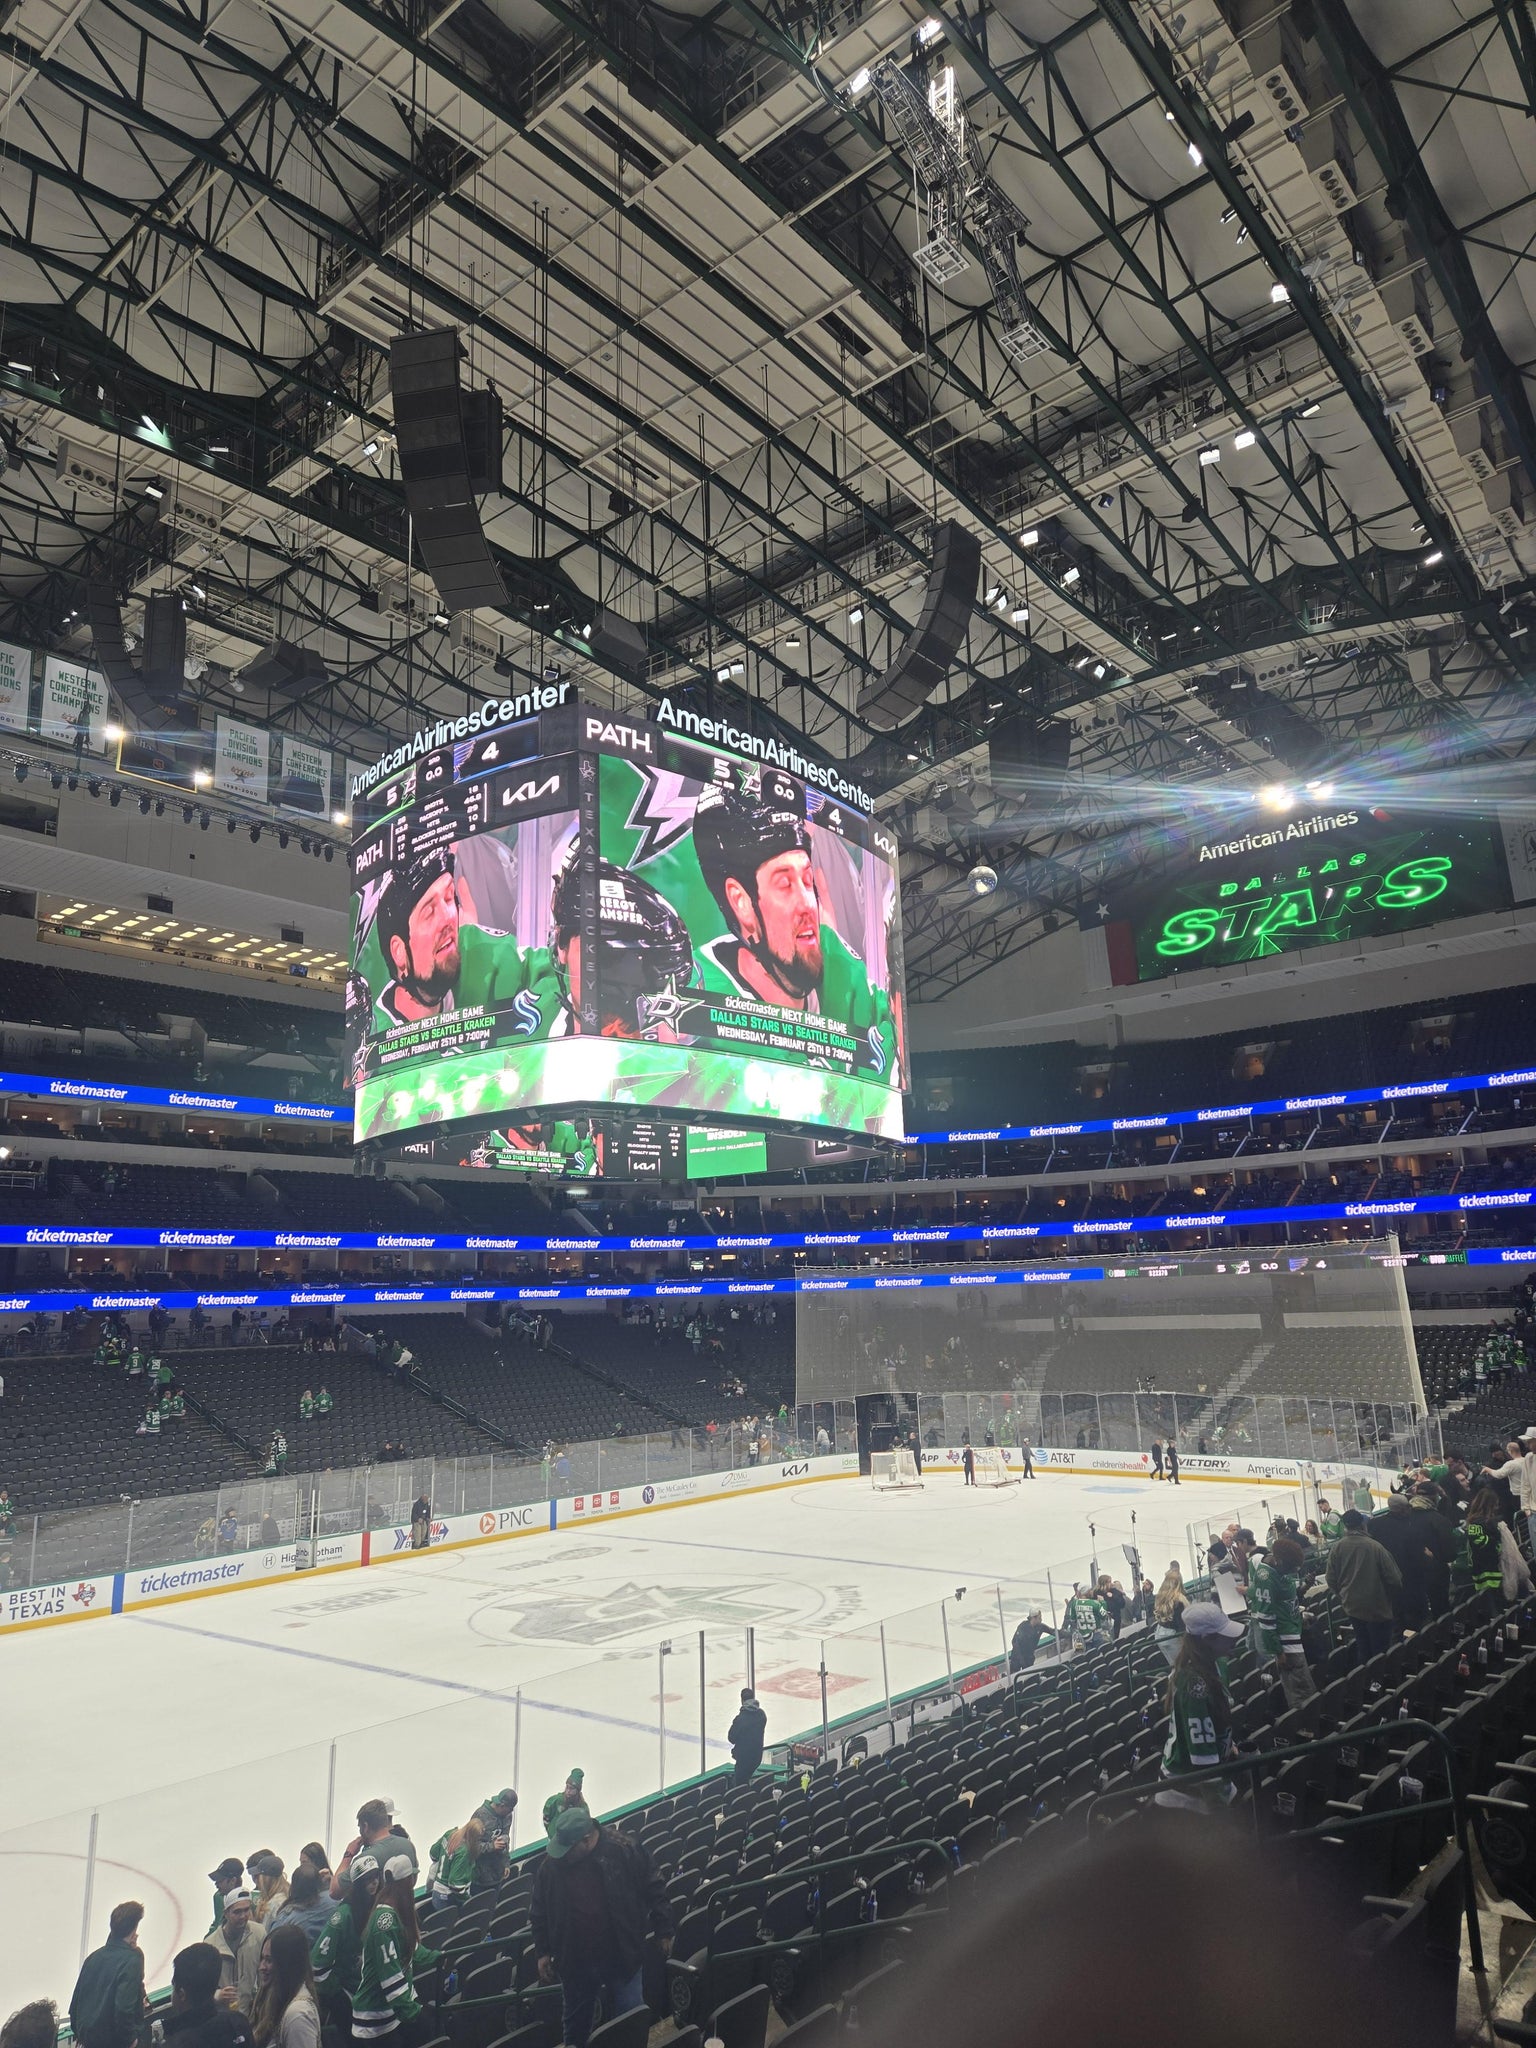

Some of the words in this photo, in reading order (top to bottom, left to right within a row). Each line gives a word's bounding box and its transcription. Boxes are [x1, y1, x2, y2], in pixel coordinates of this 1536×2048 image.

[49, 680, 104, 705] CONFERENCE
[58, 670, 97, 692] WESTERN
[228, 739, 258, 756] DIVISION
[229, 729, 257, 745] PACIFIC
[222, 748, 263, 768] CHAMPIONS
[286, 758, 328, 779] CONFERENCE
[292, 749, 322, 766] WESTERN
[386, 785, 397, 807] 5
[425, 766, 443, 781] 0.0
[481, 741, 499, 760] 4
[223, 782, 258, 797] 1999-2000
[714, 757, 731, 779] 5
[774, 783, 795, 801] 0.0
[829, 808, 842, 826] 4
[424, 798, 444, 811] SHOTS
[426, 818, 441, 829] HITS
[772, 812, 799, 824] CCM
[397, 843, 405, 852] 17
[411, 830, 436, 844] BLOCKED
[436, 821, 457, 834] SHOTS
[468, 813, 479, 822] 10
[413, 838, 438, 853] PENALTY
[438, 832, 455, 842] MINS
[584, 792, 596, 872] TEXAS
[1199, 828, 1285, 862] American
[1286, 808, 1359, 838] Airlines
[1219, 852, 1367, 897] DALLAS
[1155, 856, 1452, 957] STARS
[584, 890, 596, 990] HOCKEY
[386, 1022, 420, 1039] ticketmaster
[420, 1016, 438, 1028] NEXT
[440, 1011, 460, 1024] HOME
[462, 1005, 484, 1018] GAME
[725, 995, 779, 1017] ticketmaster
[782, 1007, 803, 1021] NEXT
[804, 1011, 826, 1028] HOME
[827, 1018, 848, 1034] GAME
[379, 1042, 398, 1054] DALLAS
[399, 1034, 419, 1048] STARS
[421, 1031, 430, 1040] VS
[431, 1023, 462, 1039] SEATTLE
[464, 1016, 496, 1031] KRAKEN
[710, 1009, 750, 1029] DALLAS
[750, 1016, 780, 1033] STARS
[782, 1023, 794, 1035] VS
[796, 1027, 828, 1043] SEATTLE
[830, 1033, 857, 1050] KRAKEN
[717, 1025, 768, 1045] WEDNESDAY,
[769, 1034, 806, 1051] FEBRUARY
[807, 1042, 824, 1055] 25TH
[411, 1042, 439, 1056] FEBRUARY
[441, 1036, 456, 1048] 25TH
[51, 1081, 127, 1098] ticketmaster
[168, 1093, 238, 1110] ticketmaster
[273, 1104, 334, 1118] ticketmaster
[949, 1132, 1000, 1141] ticketmaster
[1030, 1125, 1082, 1136] ticketmaster
[1113, 1118, 1168, 1129] ticketmaster
[1198, 1107, 1253, 1120] ticketmaster
[1286, 1096, 1346, 1110] ticketmaster
[1382, 1084, 1448, 1098] ticketmaster
[26, 1229, 113, 1243] ticketmaster
[160, 1232, 235, 1244] ticketmaster
[276, 1234, 341, 1246] ticketmaster
[377, 1236, 435, 1246] ticketmaster
[467, 1237, 518, 1248] ticketmaster
[546, 1239, 600, 1248] ticketmaster
[630, 1238, 685, 1248] ticketmaster
[717, 1237, 772, 1246] ticketmaster
[805, 1234, 860, 1244] ticketmaster
[892, 1231, 949, 1241] ticketmaster
[983, 1227, 1039, 1237] ticketmaster
[1073, 1222, 1132, 1232] ticketmaster
[1166, 1215, 1225, 1227] ticketmaster
[1345, 1202, 1416, 1215] ticketmaster
[1459, 1193, 1531, 1207] ticketmaster
[1217, 1264, 1227, 1273] 5
[1260, 1262, 1279, 1271] 0.0
[1315, 1259, 1327, 1269] 4
[93, 1296, 160, 1307] ticketmaster
[198, 1295, 258, 1305] ticketmaster
[291, 1293, 345, 1302] ticketmaster
[375, 1291, 424, 1300] ticketmaster
[451, 1290, 495, 1299] ticketmaster
[519, 1289, 560, 1297] ticketmaster
[587, 1288, 631, 1296] ticketmaster
[656, 1286, 702, 1294] ticketmaster
[729, 1284, 775, 1292] ticketmaster
[801, 1280, 849, 1289] ticketmaster
[875, 1278, 922, 1287] ticketmaster
[950, 1276, 997, 1284] ticketmaster
[1024, 1272, 1071, 1281] ticketmaster
[1050, 1453, 1076, 1464] AT&T
[1178, 1458, 1227, 1468] VICTORY
[1247, 1463, 1296, 1476] American
[499, 1509, 533, 1530] PNC
[140, 1562, 244, 1594] ticketmaster
[9, 1589, 46, 1605] BEST
[51, 1586, 66, 1598] IN
[1255, 1588, 1271, 1603] 44
[9, 1599, 64, 1620] TEXAS
[1188, 1716, 1217, 1744] 29
[381, 1940, 398, 1964] 14
